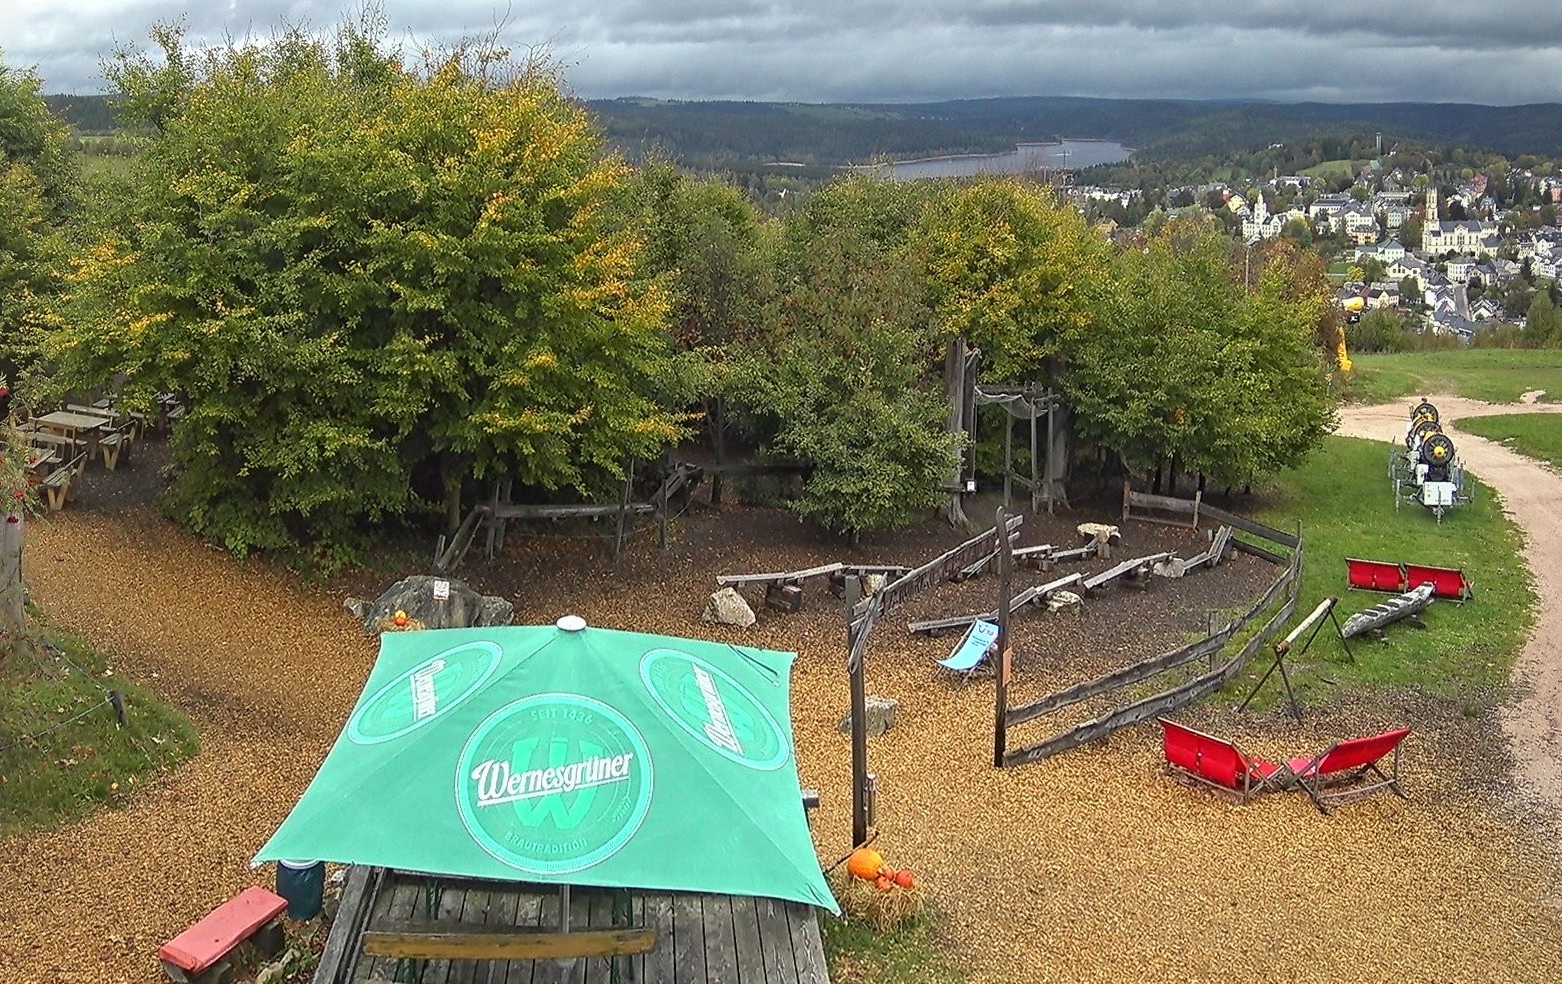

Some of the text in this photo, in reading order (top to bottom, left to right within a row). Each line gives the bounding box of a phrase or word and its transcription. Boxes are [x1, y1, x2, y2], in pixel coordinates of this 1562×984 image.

[530, 707, 593, 725] SEIT 1436
[471, 752, 634, 803] Wernesgrüner
[504, 830, 588, 854] BRAUTRADITION
